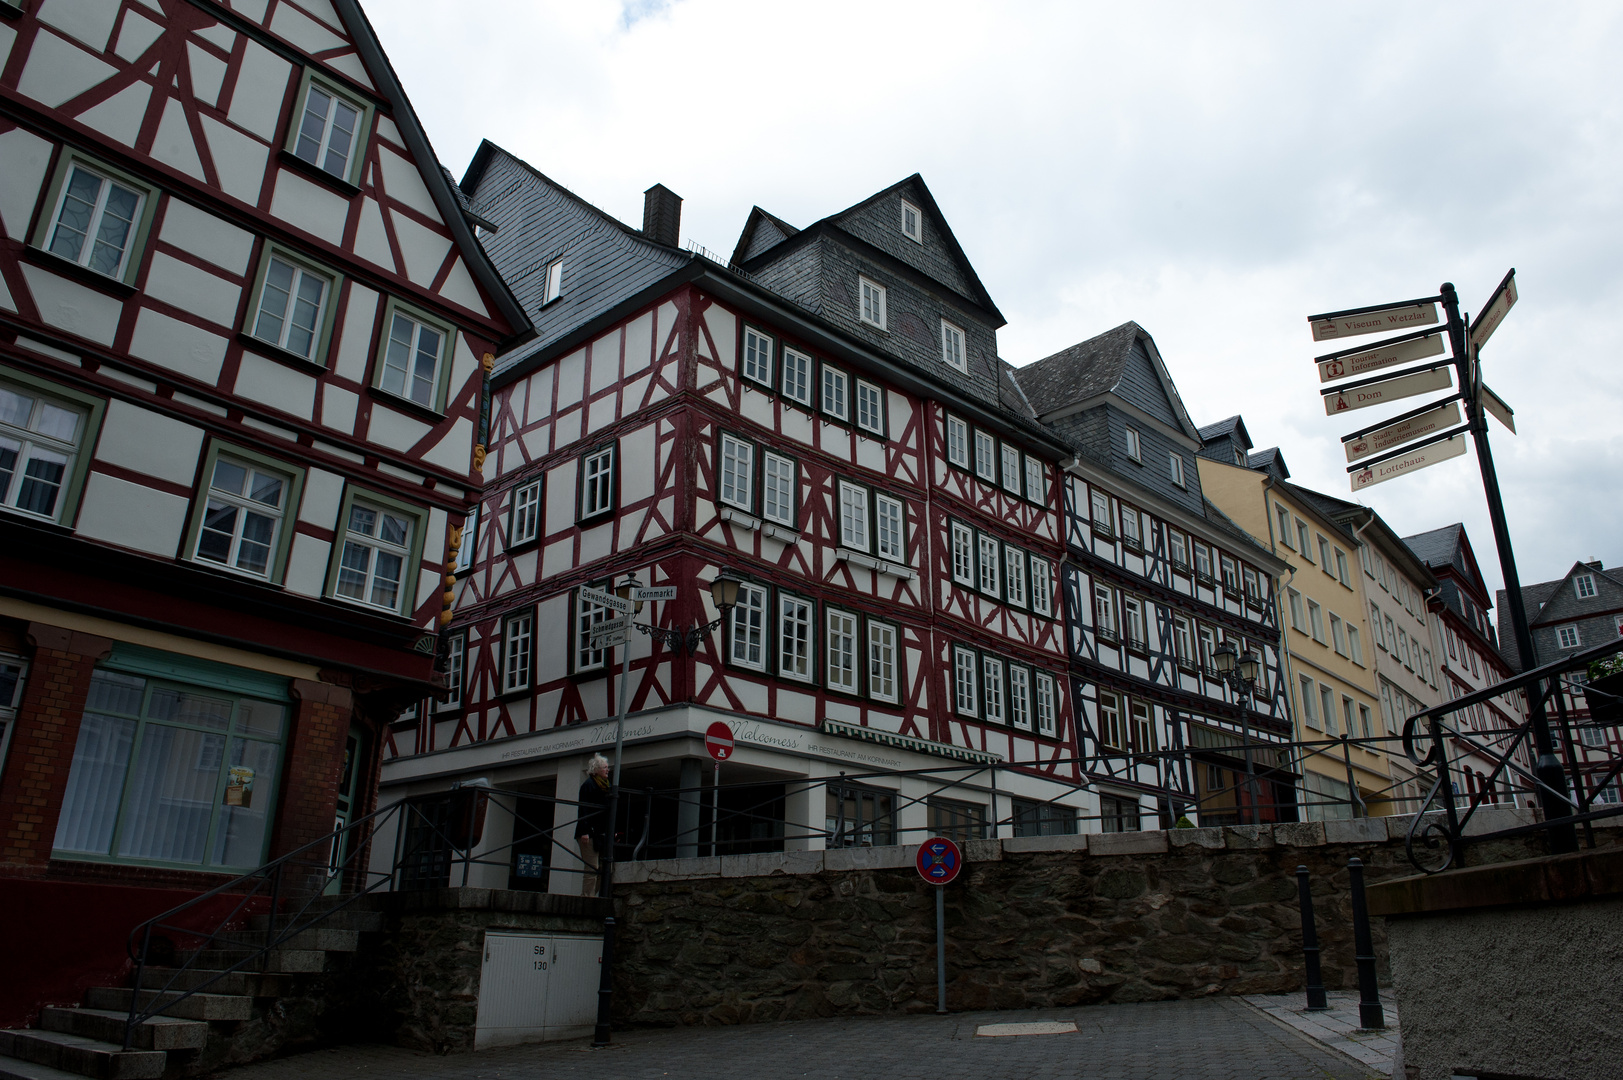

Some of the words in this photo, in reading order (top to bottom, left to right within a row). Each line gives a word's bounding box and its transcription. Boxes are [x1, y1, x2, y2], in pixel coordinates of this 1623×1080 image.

[1344, 320, 1382, 330] Viseum
[1387, 312, 1426, 323] Wetzlar
[1350, 353, 1379, 364] Tourist-
[1351, 356, 1397, 372] Information
[1357, 391, 1382, 402] Dom
[1373, 430, 1393, 442] Stadt-
[1397, 423, 1411, 433] und
[1374, 423, 1436, 449] Industriemuseum
[1380, 455, 1426, 476] Lottehaus
[582, 588, 627, 609] Gewandsgasse
[637, 588, 673, 598] Kornmarkt
[592, 620, 624, 634] Schmiedgasse
[502, 751, 510, 759] IHR
[510, 746, 542, 758] RESTAURANT
[543, 744, 551, 753] AM
[552, 738, 584, 751] KORNMARKT
[807, 743, 818, 751] IHR
[819, 745, 856, 759] RESTAURANT
[857, 752, 867, 761] AM
[867, 755, 902, 768] KORNMARKT
[533, 945, 545, 955] SB
[533, 961, 547, 971] 130
